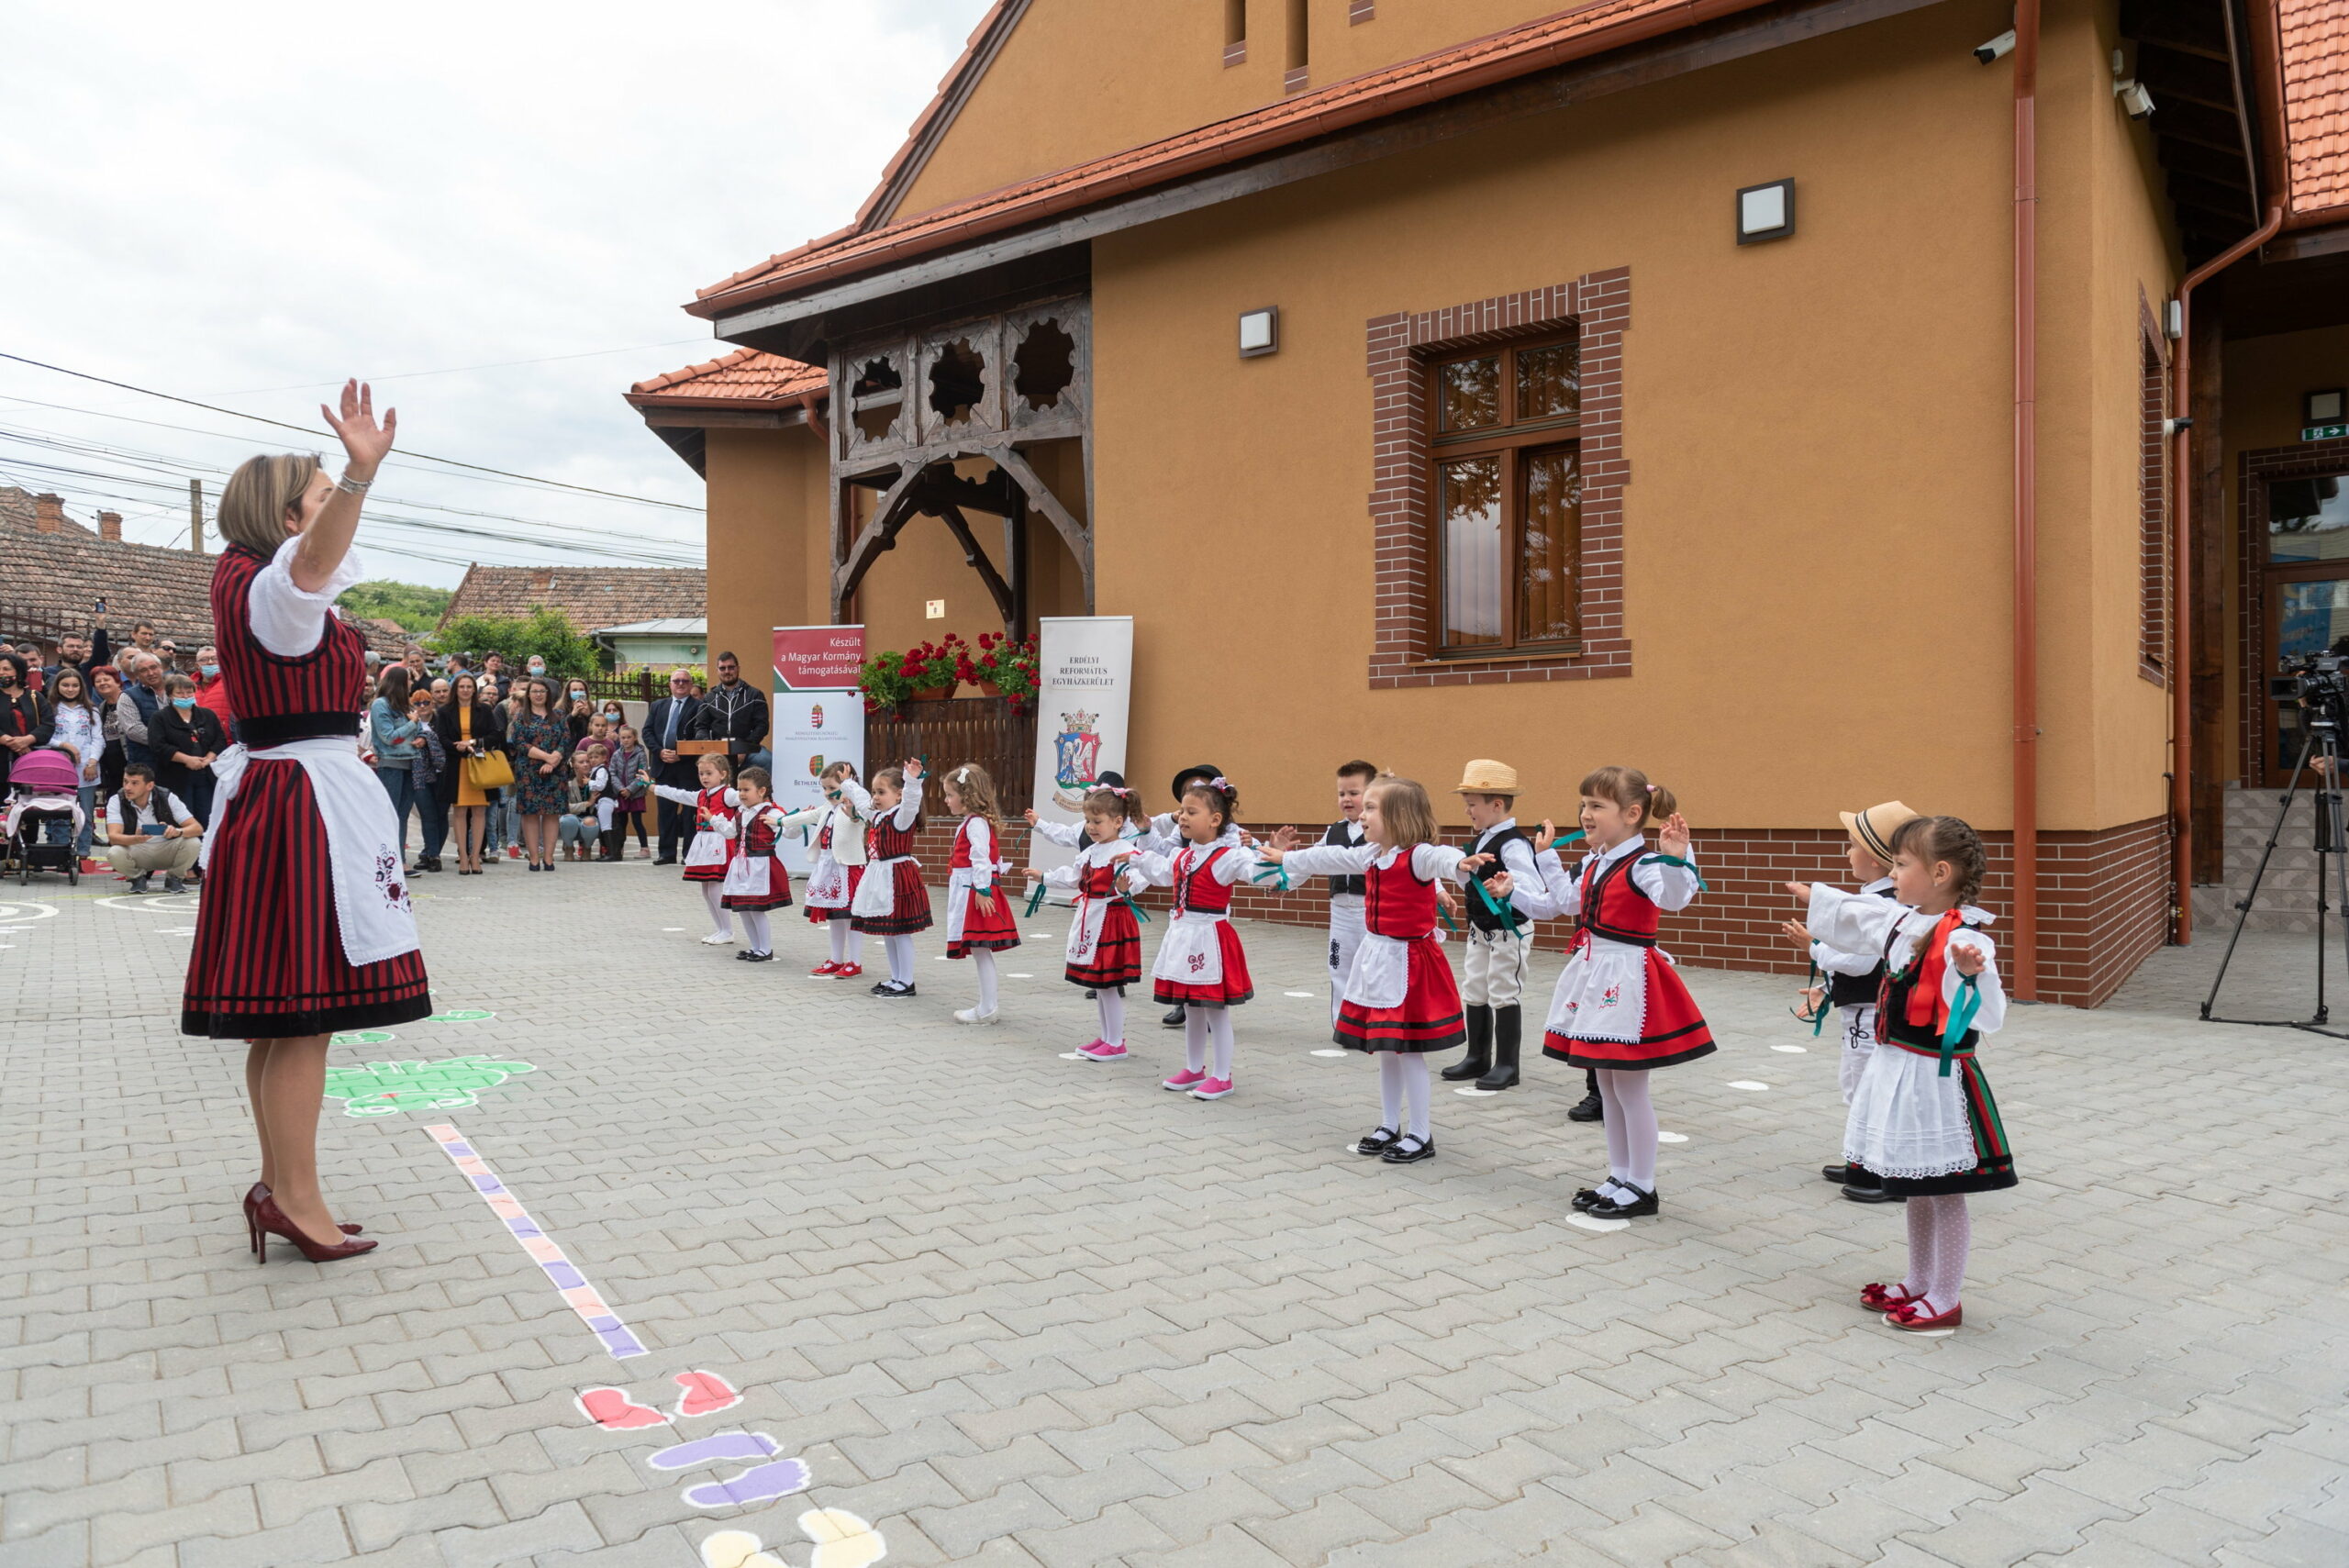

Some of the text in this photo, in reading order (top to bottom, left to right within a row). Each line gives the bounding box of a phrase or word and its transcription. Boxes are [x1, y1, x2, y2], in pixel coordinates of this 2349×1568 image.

[830, 637, 861, 646] Készült
[788, 652, 820, 663] Magyar
[823, 651, 861, 662] Kormány
[1069, 655, 1099, 664] ERDÉLYI
[798, 664, 861, 676] támogatásával
[1060, 666, 1108, 674] REFORMÁTUS
[1052, 676, 1114, 685] EGYHÁZKERÜLET
